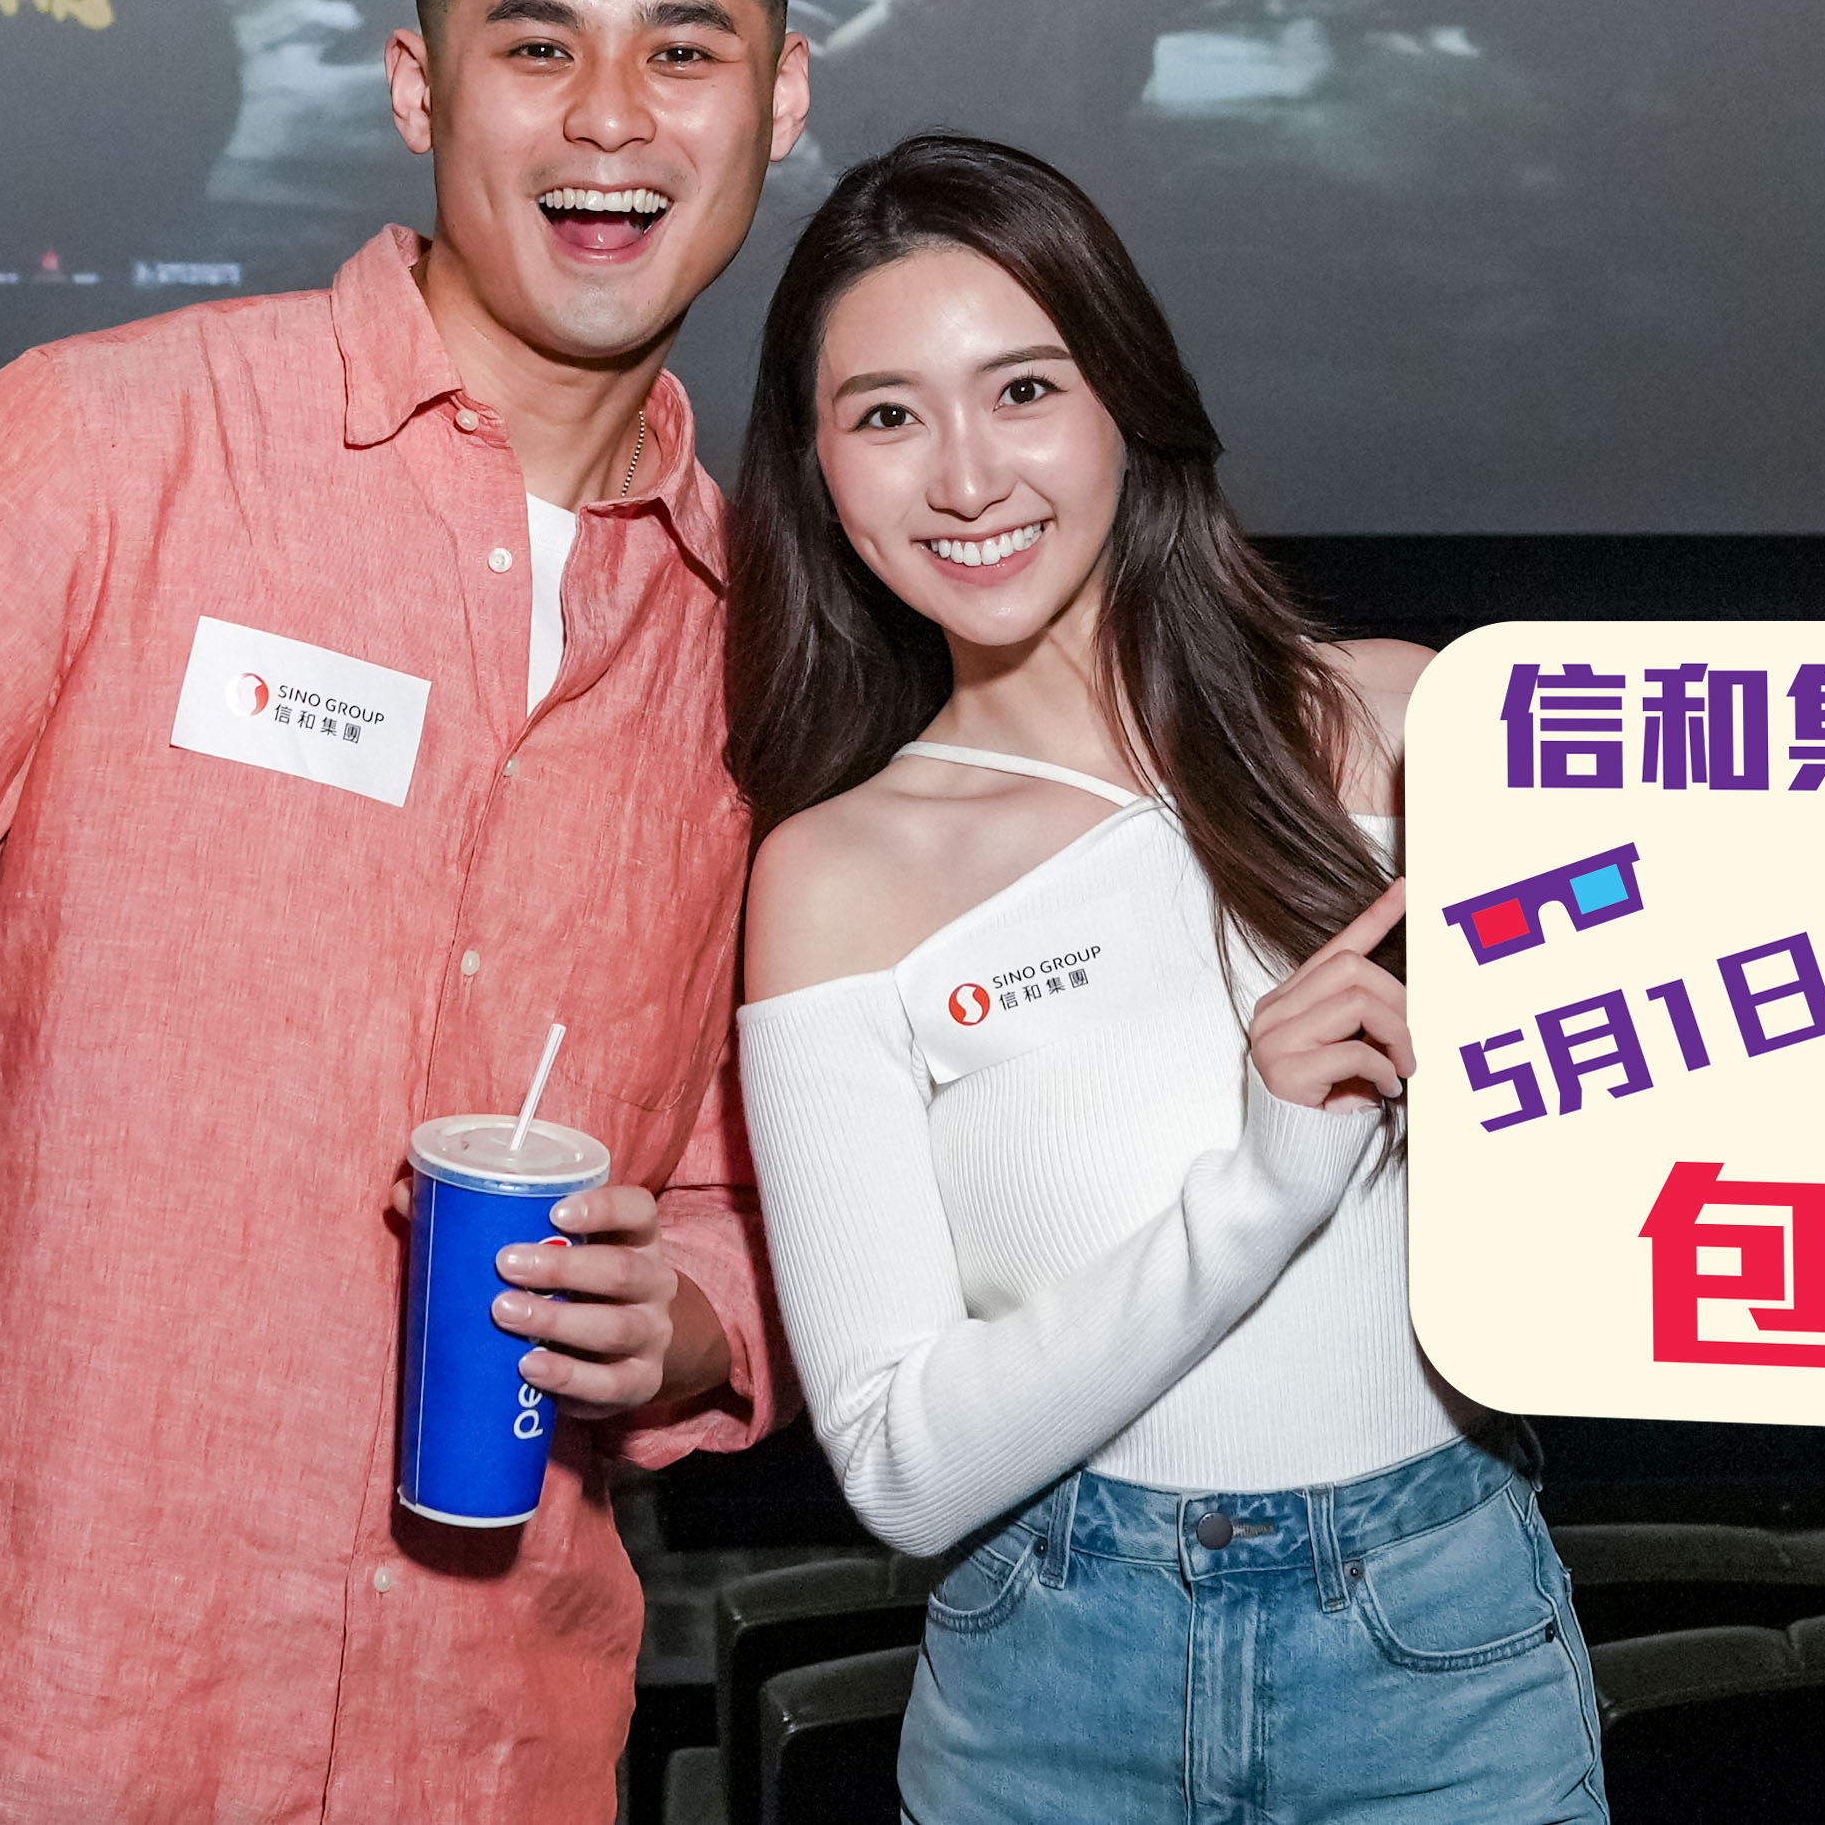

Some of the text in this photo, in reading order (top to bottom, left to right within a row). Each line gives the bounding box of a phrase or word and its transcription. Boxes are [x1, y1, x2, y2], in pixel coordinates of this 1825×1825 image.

[273, 703, 362, 745] 信和集團
[277, 684, 385, 726] SINO GROUP
[992, 945, 1102, 989] SINO GROUP
[999, 968, 1089, 1010] 信和集團
